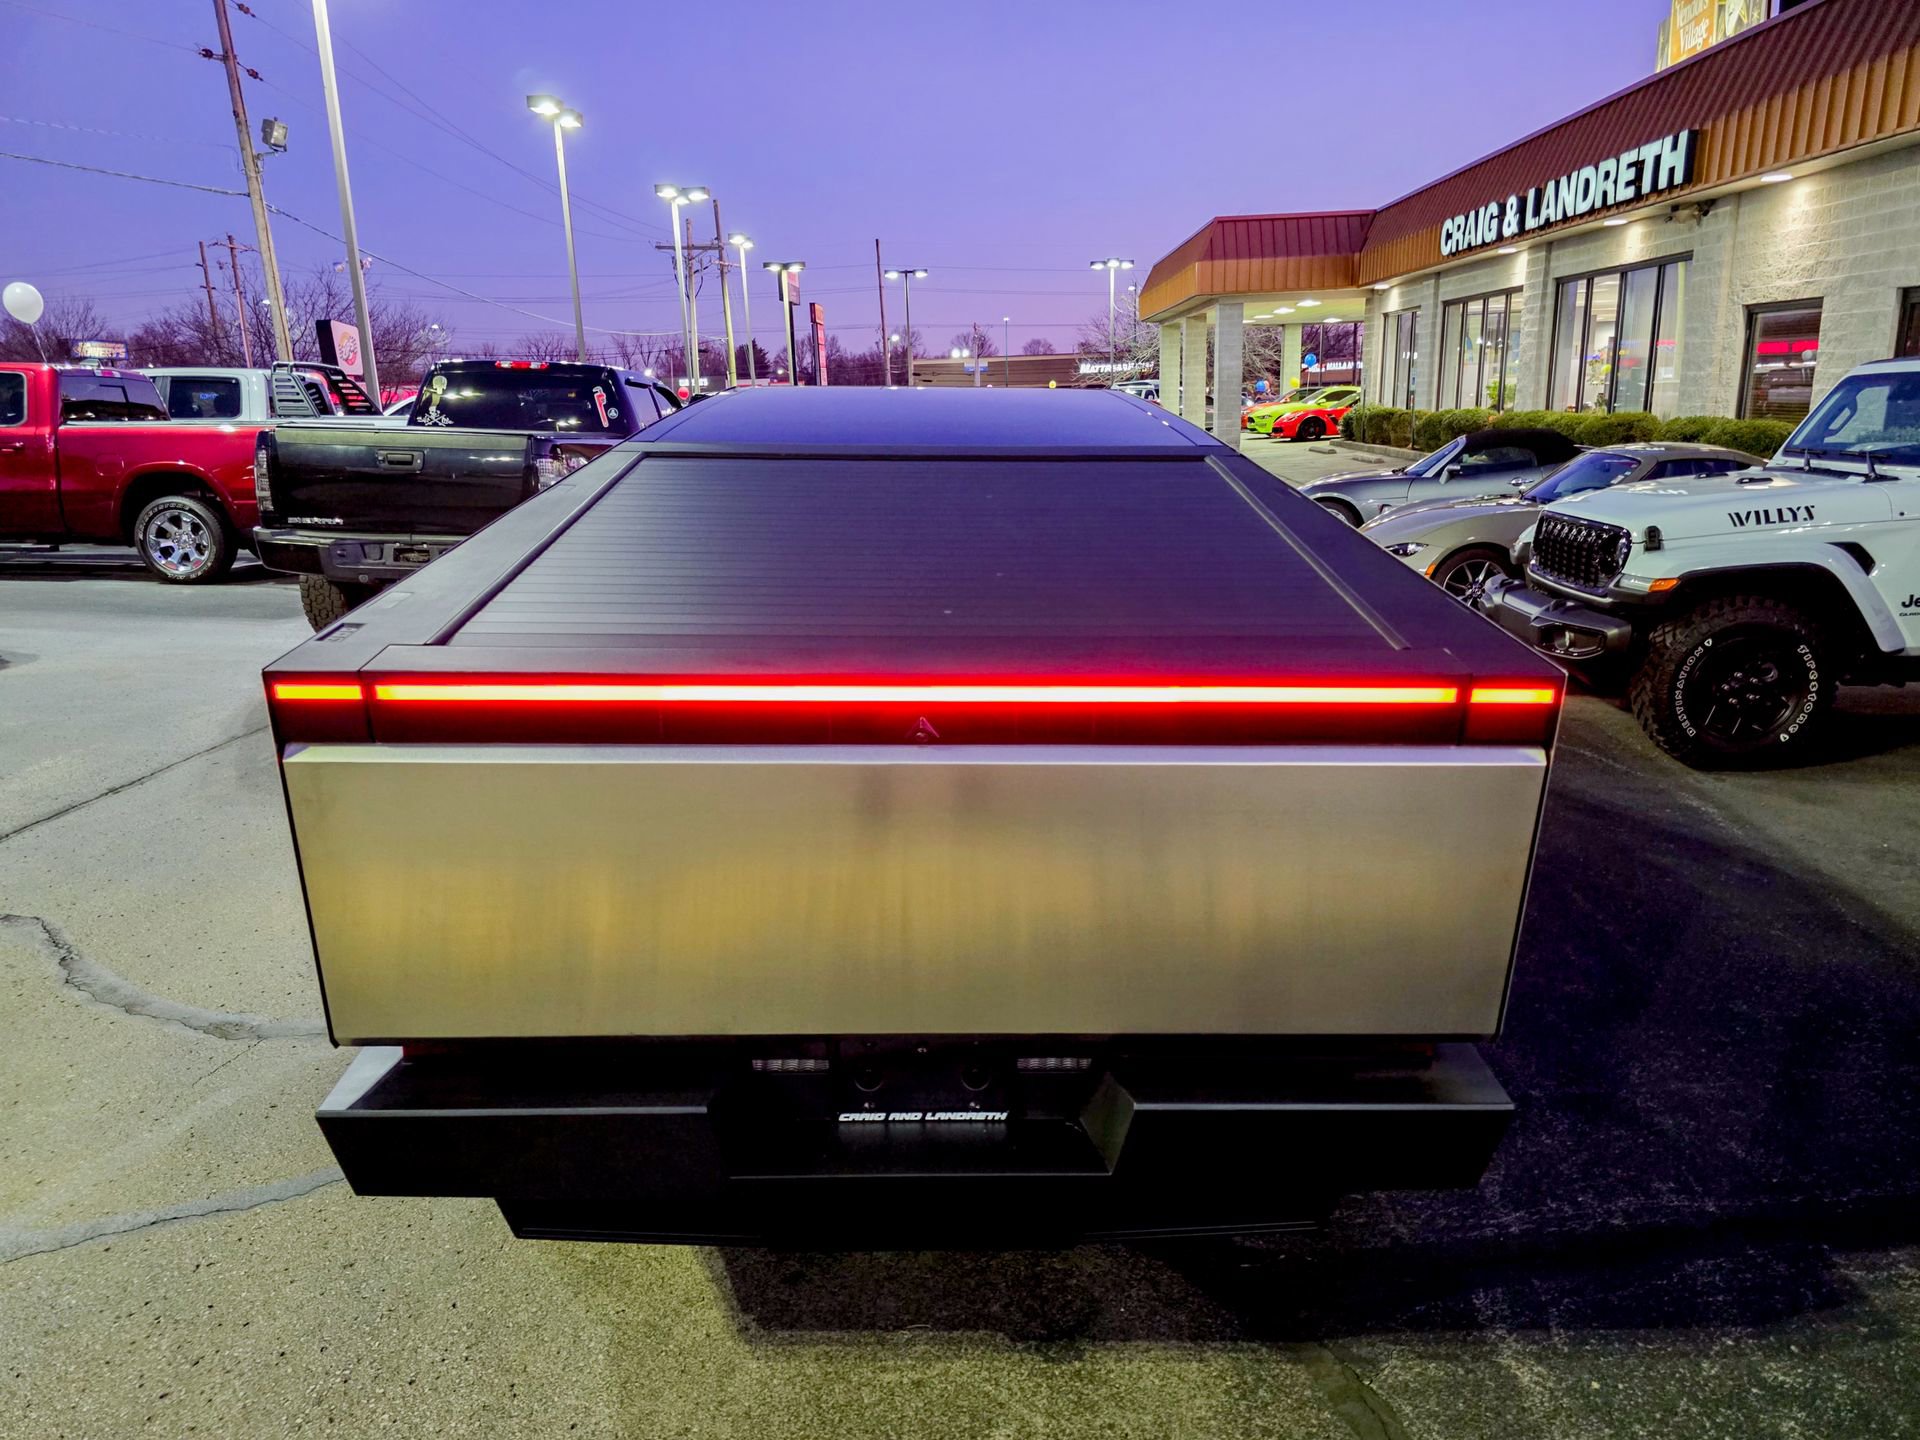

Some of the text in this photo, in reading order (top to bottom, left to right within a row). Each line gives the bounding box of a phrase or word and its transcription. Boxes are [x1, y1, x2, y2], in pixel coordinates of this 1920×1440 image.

[1680, 17, 1709, 54] Village
[1440, 129, 1690, 256] CRAIG & LANDRETH
[1728, 505, 1815, 527] WILLYS
[1675, 647, 1704, 737] DESTINATION
[838, 1111, 1008, 1122] CRAIG AND LANDRETH
